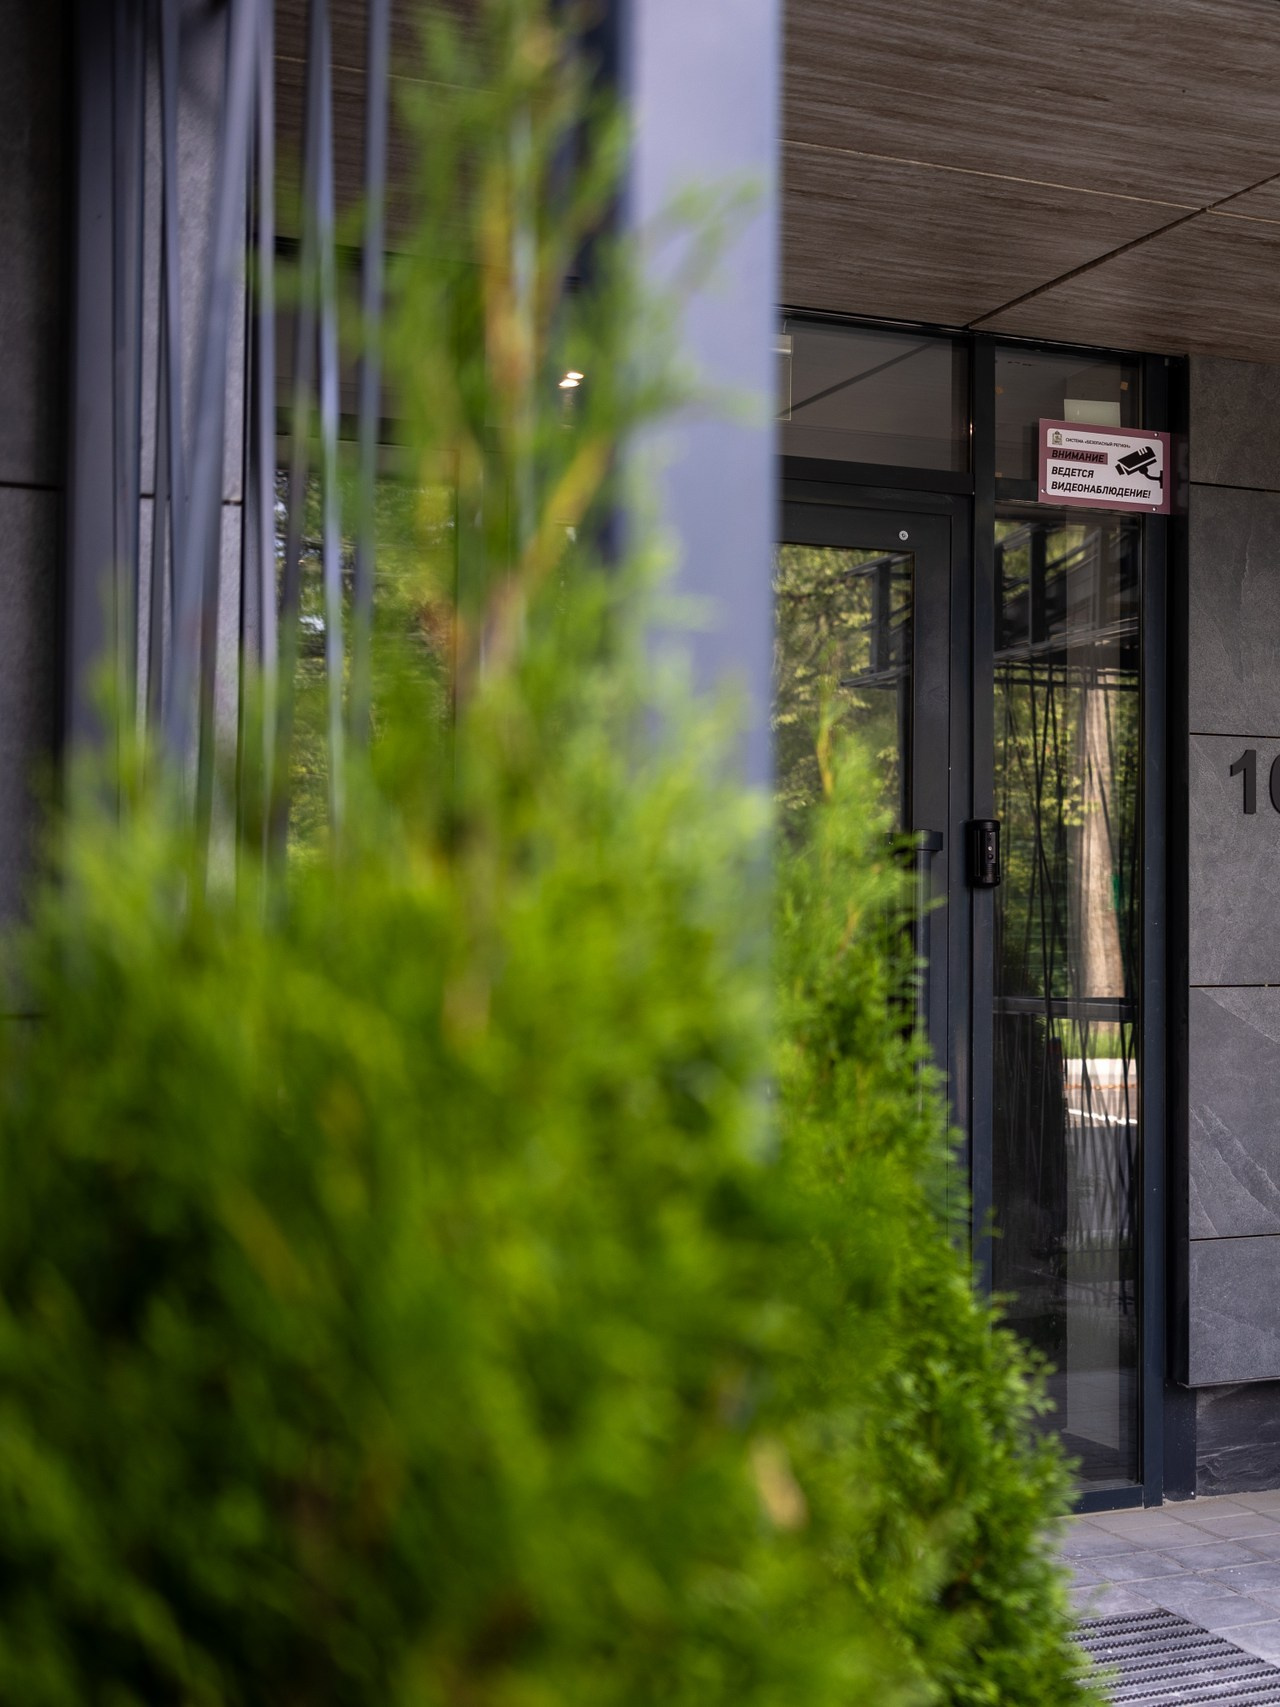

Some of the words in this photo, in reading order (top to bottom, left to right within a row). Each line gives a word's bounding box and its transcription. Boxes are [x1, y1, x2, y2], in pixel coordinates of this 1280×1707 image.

[1051, 449, 1105, 463] ВНИМАНИЕ
[1051, 466, 1095, 479] ВЕДЕТСЯ
[1051, 481, 1152, 499] ВИДЕОНАБЛЮДЕНИЕ!
